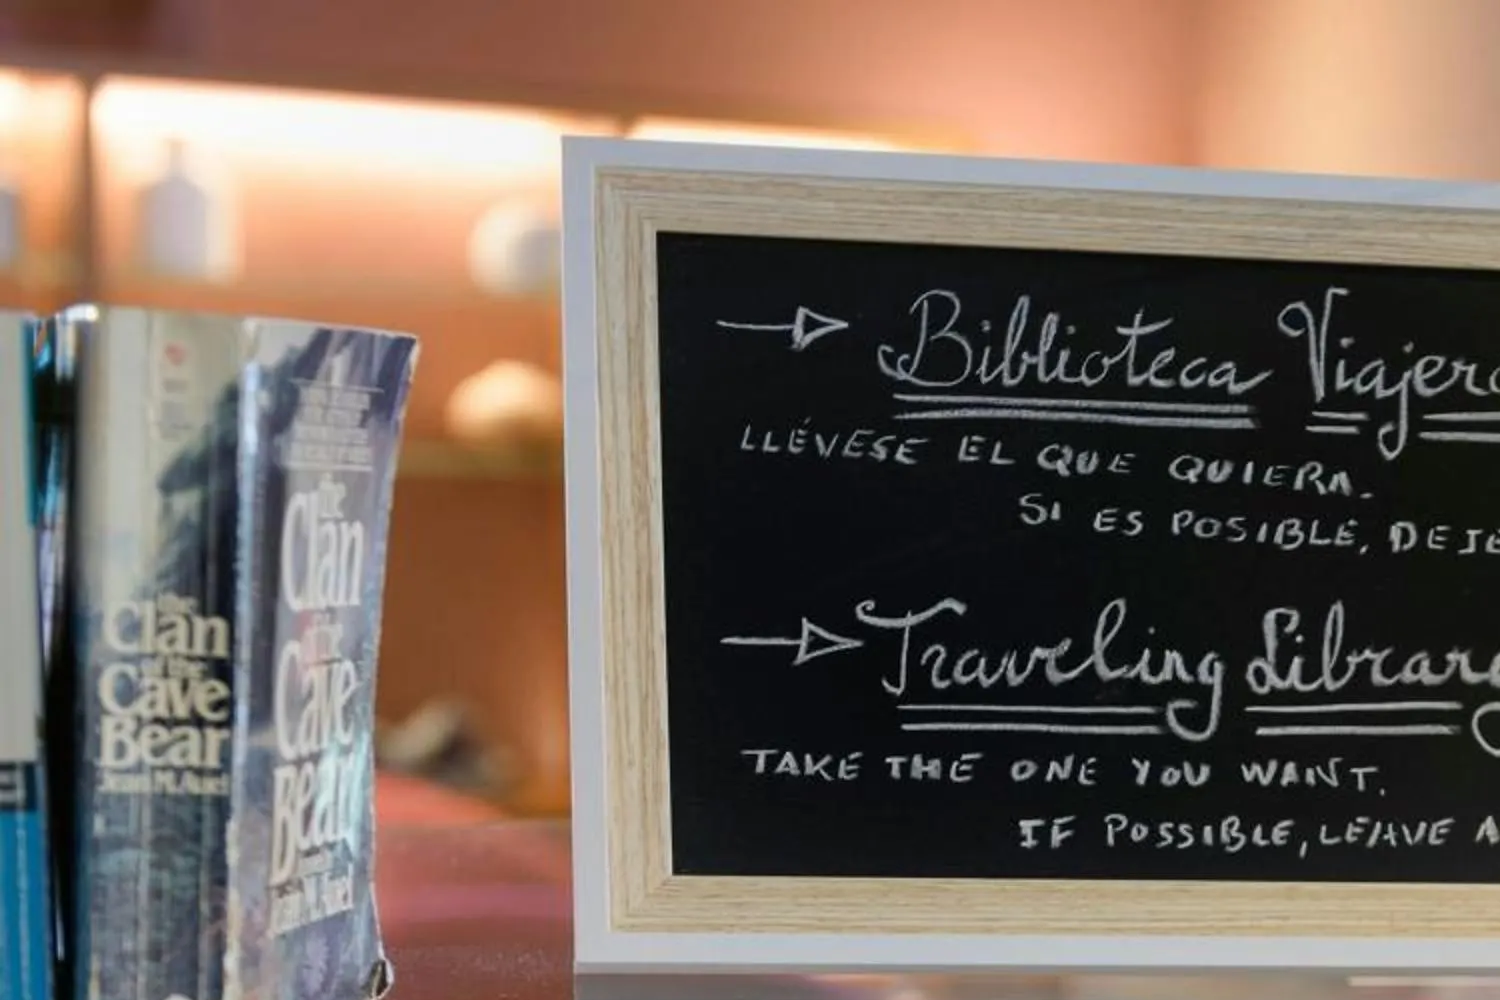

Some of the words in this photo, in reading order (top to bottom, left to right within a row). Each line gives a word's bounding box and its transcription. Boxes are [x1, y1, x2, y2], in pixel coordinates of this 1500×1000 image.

[878, 289, 1272, 387] Biblioteca
[741, 418, 931, 464] LLÉVESE
[959, 436, 1013, 464] EL
[1037, 444, 1134, 476] QUE
[281, 491, 364, 612] Clan
[1020, 494, 1060, 524] SI
[1094, 509, 1142, 535] ES
[1172, 510, 1367, 554] POSIBLE,
[102, 599, 230, 659] Clan
[99, 664, 231, 722] Cave
[856, 598, 1225, 741] Traveling
[275, 640, 361, 761] Cave
[97, 714, 231, 770] Bear
[742, 750, 861, 780] TAKE
[885, 753, 981, 782] THE
[1011, 755, 1096, 785] ONE
[1132, 759, 1210, 786] YOU
[269, 742, 365, 886] Bear
[1019, 816, 1074, 848] IF
[1105, 814, 1307, 857] POSSIBLE,
[1320, 817, 1454, 847] LEAVE
